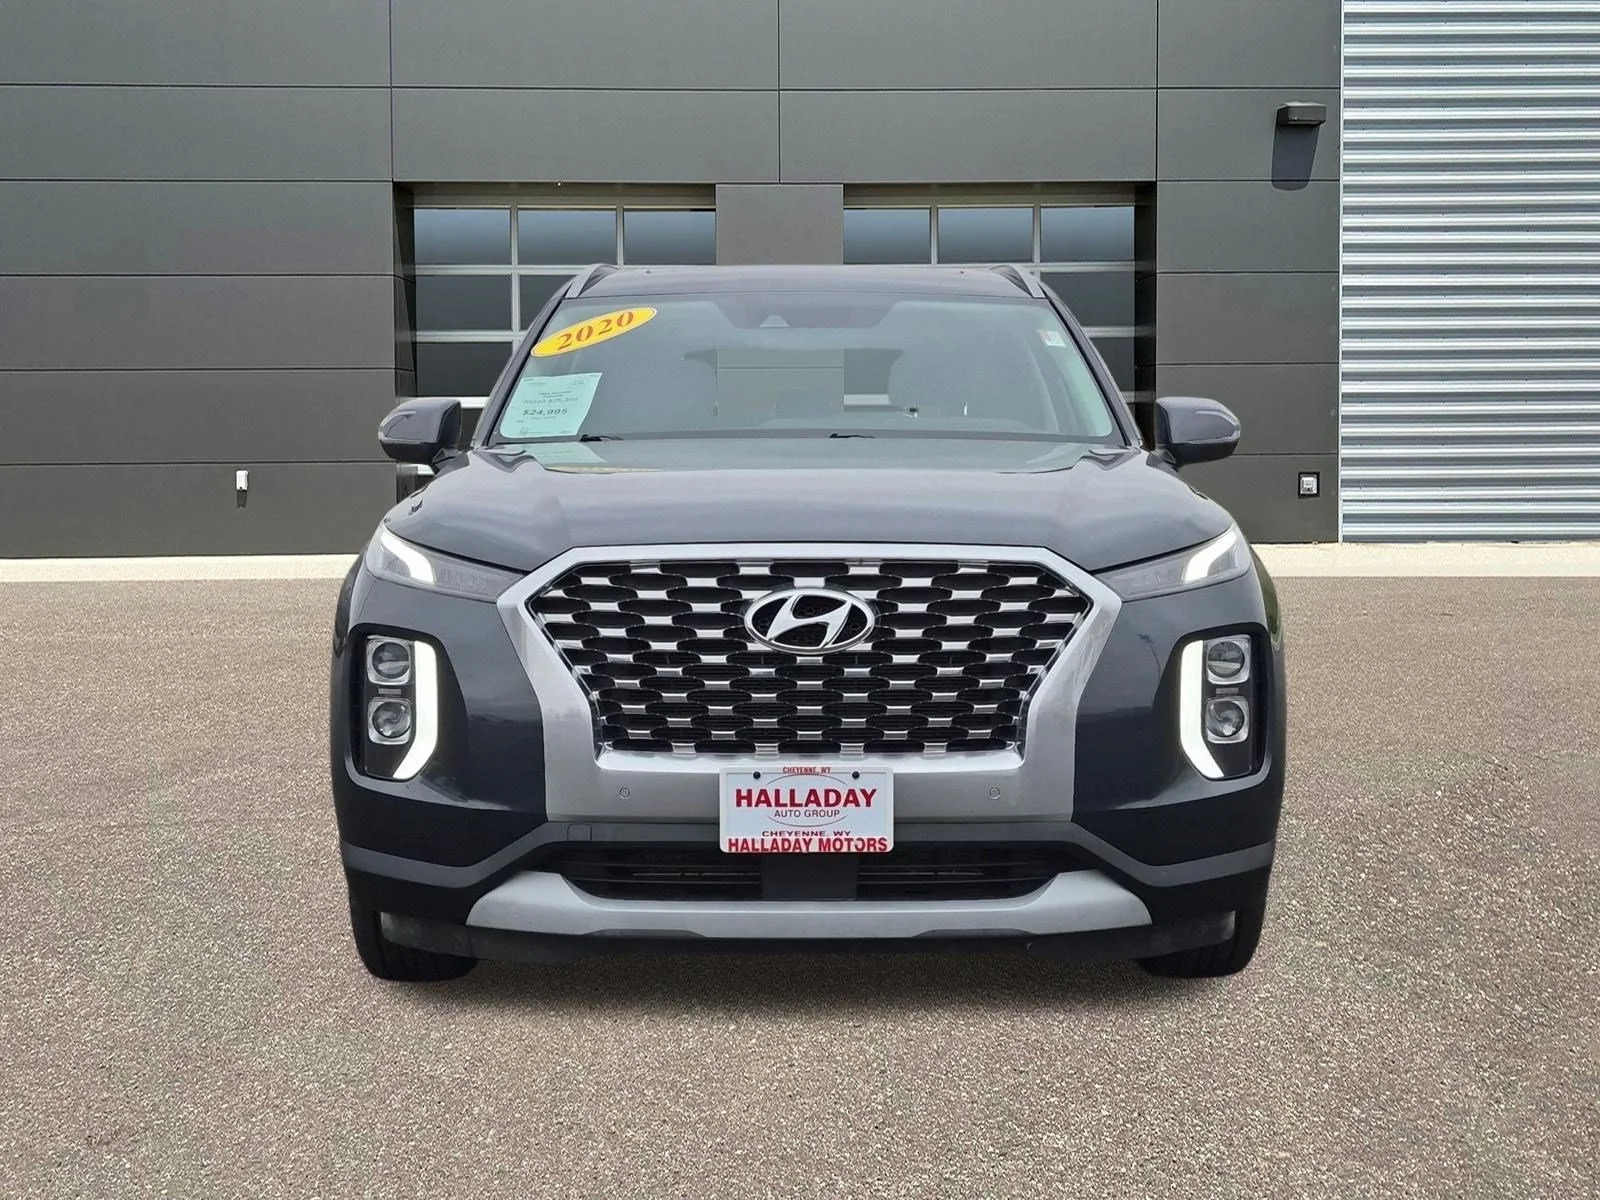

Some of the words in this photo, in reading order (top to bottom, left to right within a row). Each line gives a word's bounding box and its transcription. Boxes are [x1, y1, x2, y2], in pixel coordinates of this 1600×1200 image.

[557, 311, 634, 351] 2020
[522, 408, 568, 416] $24,995
[820, 766, 832, 774] WY
[735, 788, 877, 808] HALLADAY
[774, 809, 801, 818] AUTO
[803, 809, 840, 818] GROUP
[728, 838, 813, 852] HALLADAY
[818, 837, 888, 852] MOTORS
